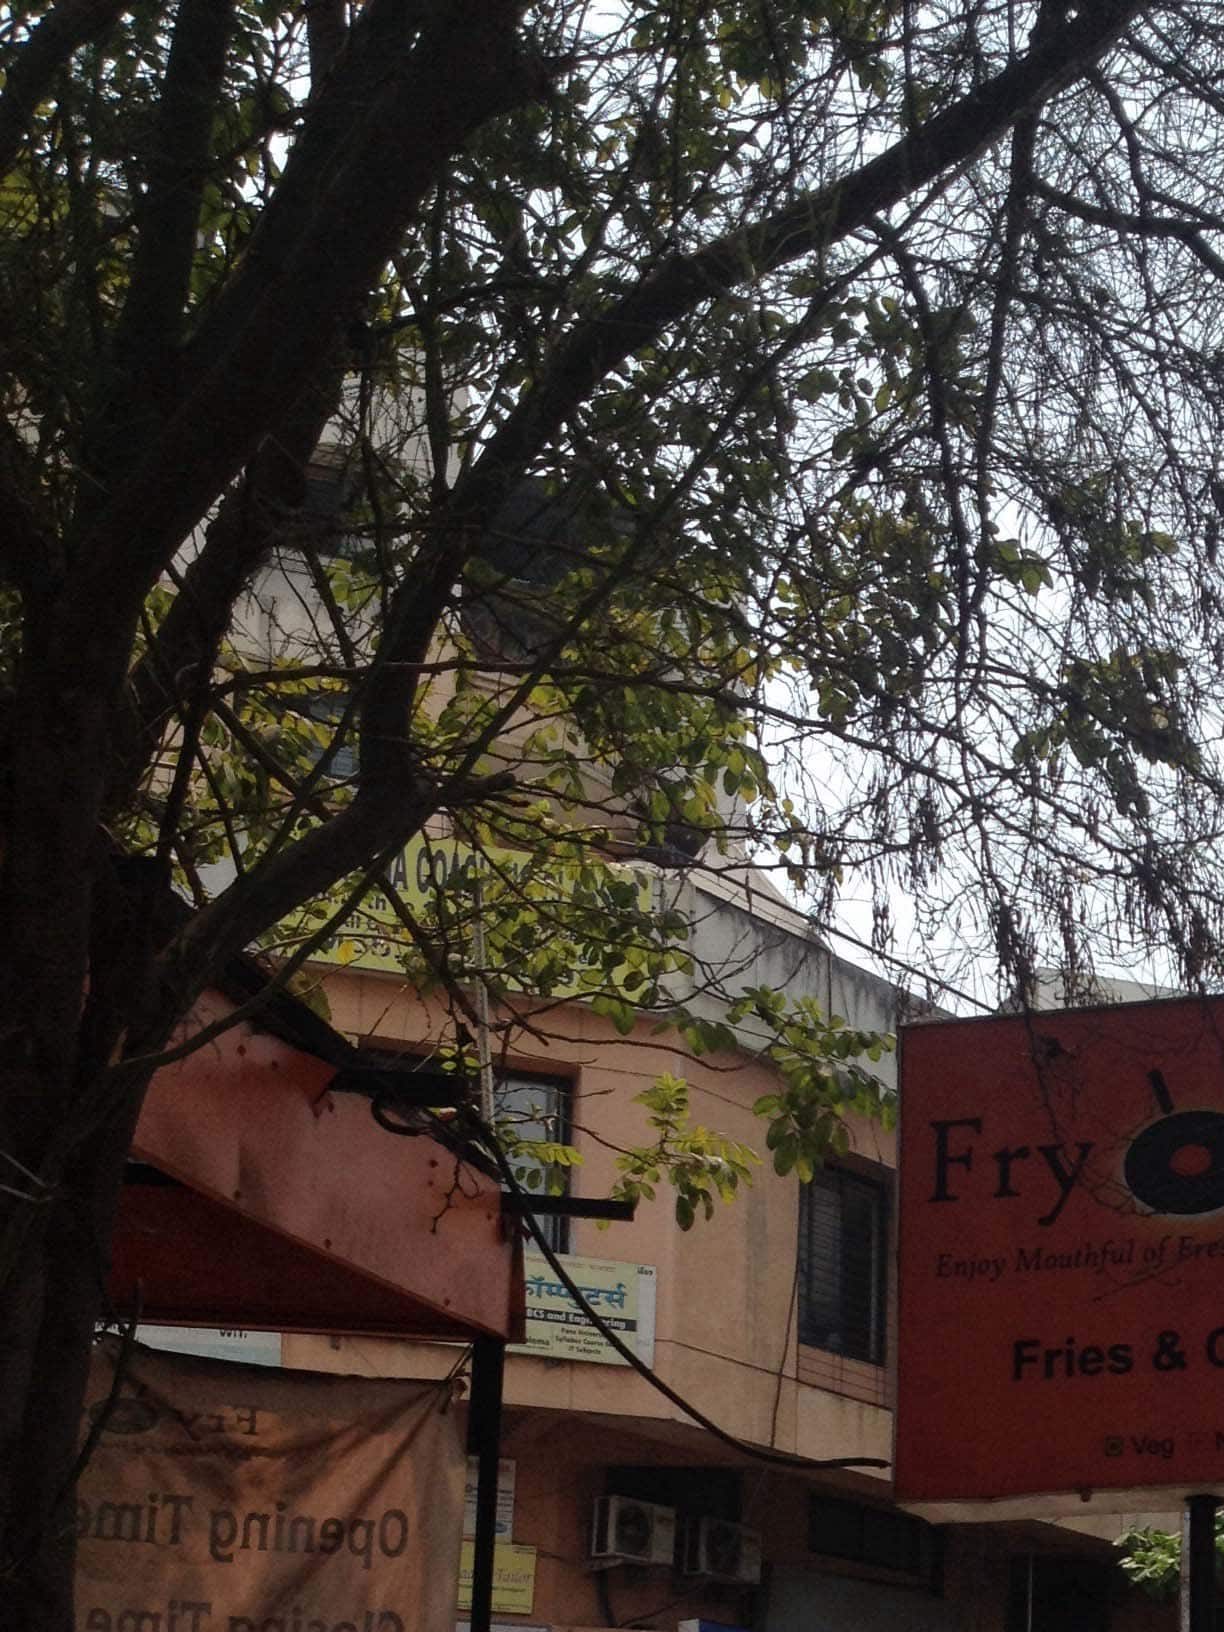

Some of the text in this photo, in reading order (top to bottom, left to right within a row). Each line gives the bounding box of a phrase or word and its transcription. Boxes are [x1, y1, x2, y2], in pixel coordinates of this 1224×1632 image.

[929, 1117, 1095, 1226] Fry
[935, 1253, 1006, 1282] Enjoy
[1014, 1239, 1135, 1274] Mouthful
[1143, 1236, 1172, 1270] of
[546, 1312, 567, 1321] and
[1012, 1338, 1134, 1381] Fries
[1152, 1330, 1187, 1373] &
[1130, 1436, 1176, 1460] Veg
